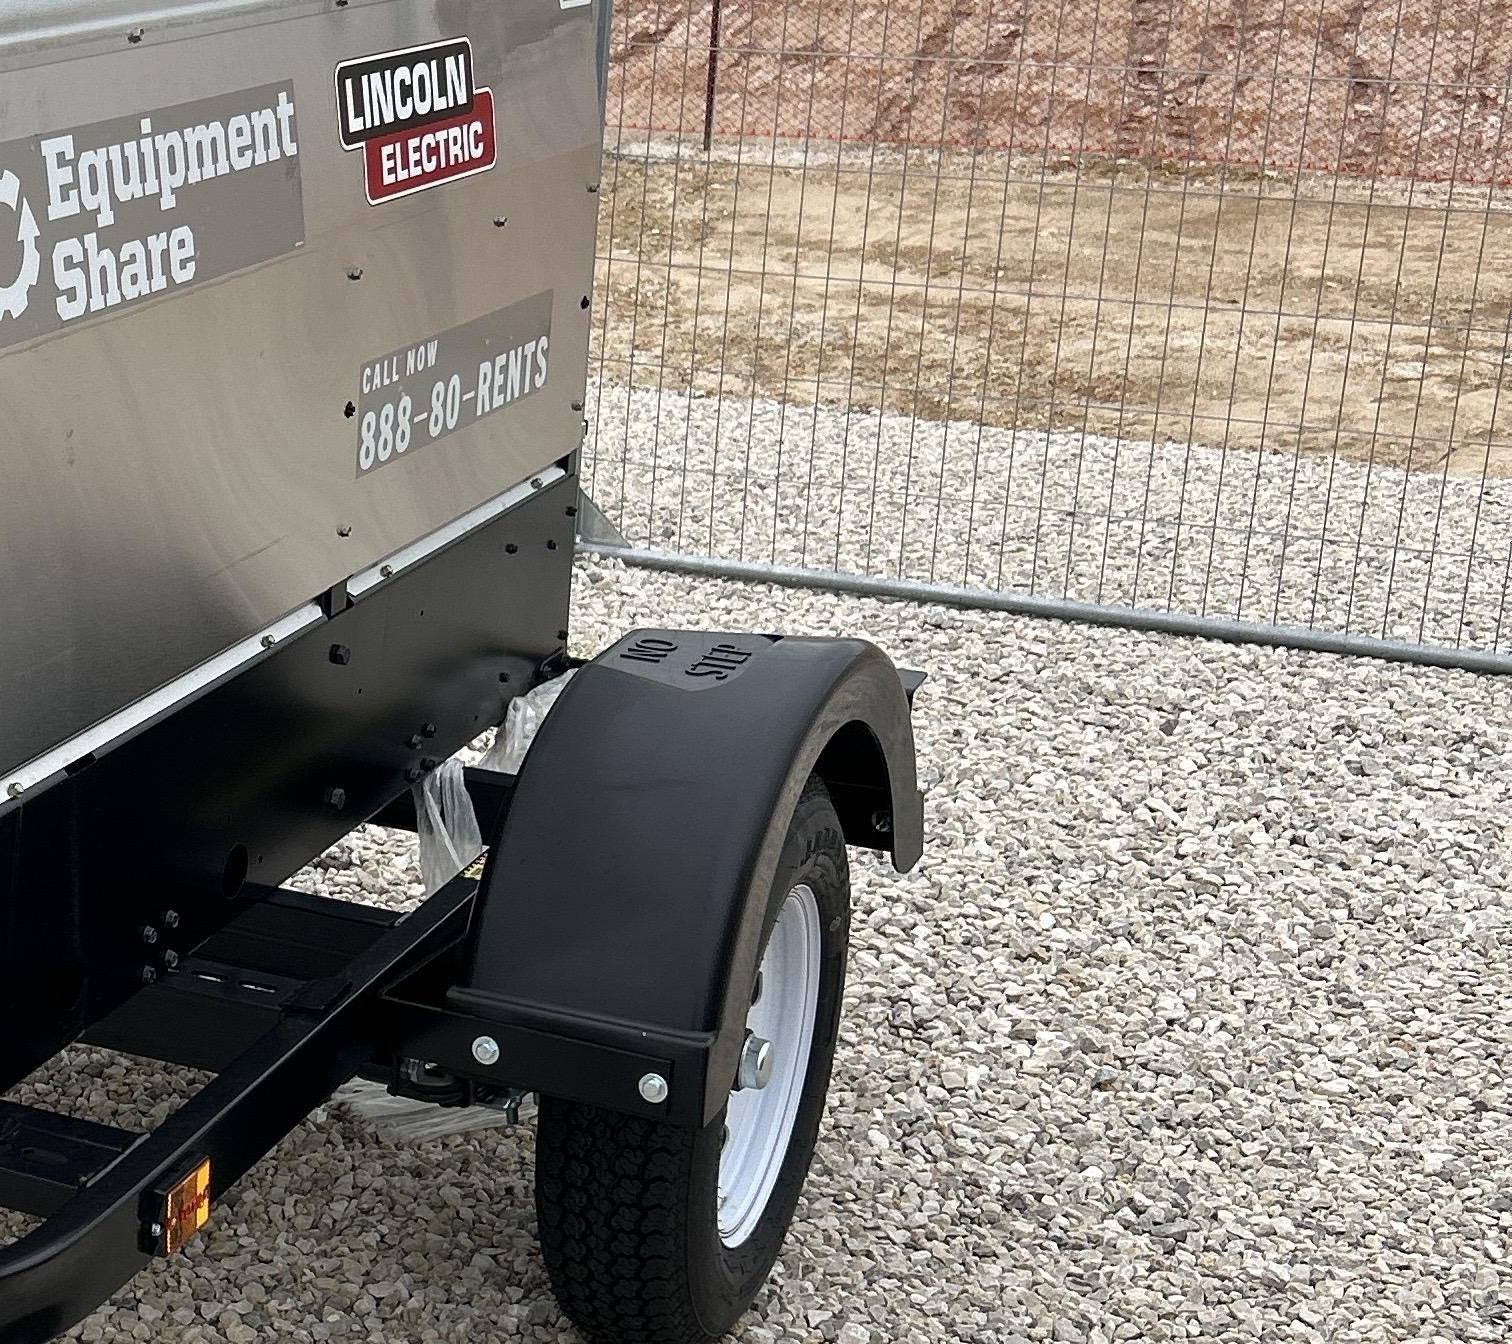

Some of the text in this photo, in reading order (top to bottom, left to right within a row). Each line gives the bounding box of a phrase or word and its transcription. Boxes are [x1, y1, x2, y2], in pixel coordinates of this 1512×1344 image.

[345, 53, 468, 134] LINCOLN
[40, 91, 298, 228] Equipment
[381, 120, 484, 186] ELECTRIC
[52, 225, 196, 321] Share
[359, 335, 549, 471] 888-80-RENTS
[362, 339, 438, 395] CALL NOW
